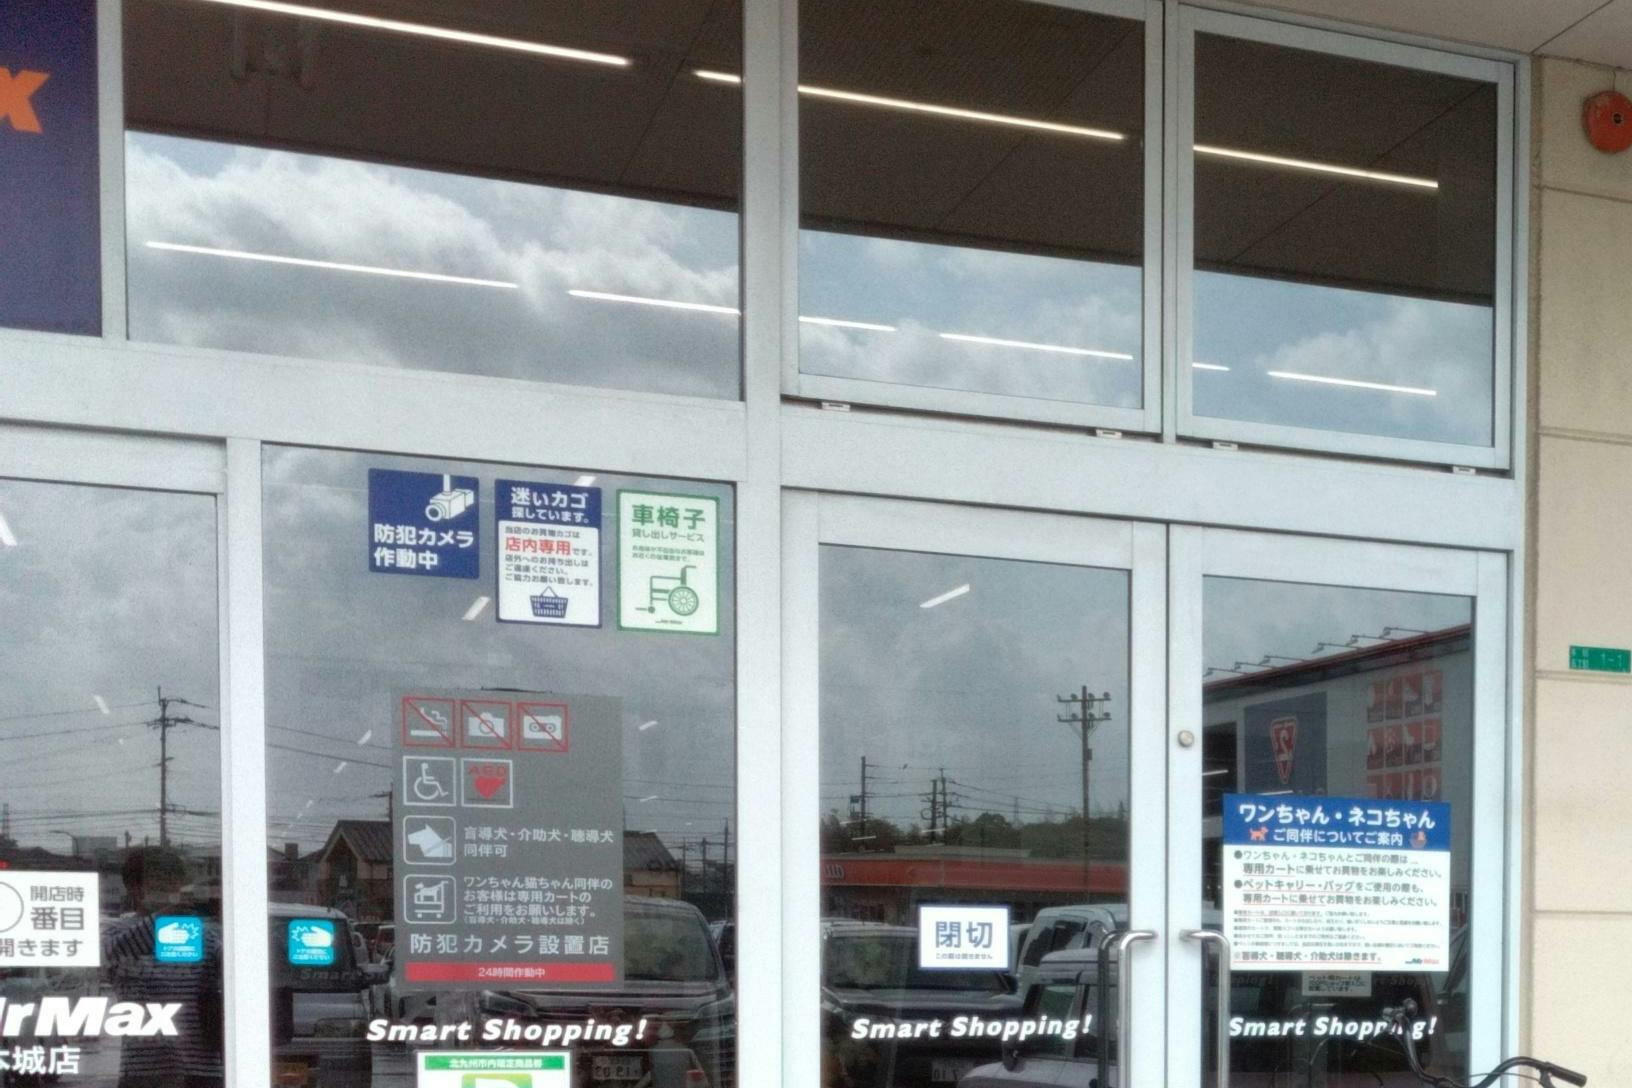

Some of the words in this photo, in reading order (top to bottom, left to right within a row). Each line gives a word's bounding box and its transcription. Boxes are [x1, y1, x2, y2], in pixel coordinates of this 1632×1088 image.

[511, 486, 589, 509] 迷いカゴ
[511, 507, 590, 524] 探しています。
[632, 504, 706, 530] 車椅子
[374, 523, 474, 548] 防犯カメラ
[632, 528, 705, 542] 貸し出しサービス
[374, 547, 438, 570] 作動中
[468, 765, 509, 775] AED
[1239, 803, 1436, 830] ワンちゃん・ネコちゃん
[463, 826, 614, 844] 盲導犬・介助犬・聴導犬
[1273, 828, 1403, 847] ご同伴についてご案内
[463, 843, 508, 858] 同伴可
[463, 875, 613, 891] ワンちゃん猫ちゃん同伴の
[30, 885, 84, 902] 開店時
[463, 889, 592, 904] お客様は専用カートの
[31, 905, 84, 931] 番目
[463, 902, 597, 917] ご利用をお願いします。
[410, 932, 609, 955] 防犯カメラ設置店
[935, 920, 993, 949] 閉切
[478, 967, 546, 978] 24時間作動中
[0, 996, 182, 1037] rMax
[366, 1019, 472, 1042] Smart
[482, 1018, 648, 1046] Shopping!
[851, 1018, 942, 1039] Smart
[950, 1014, 1093, 1041] Shopping!
[1229, 1017, 1306, 1037] Smart
